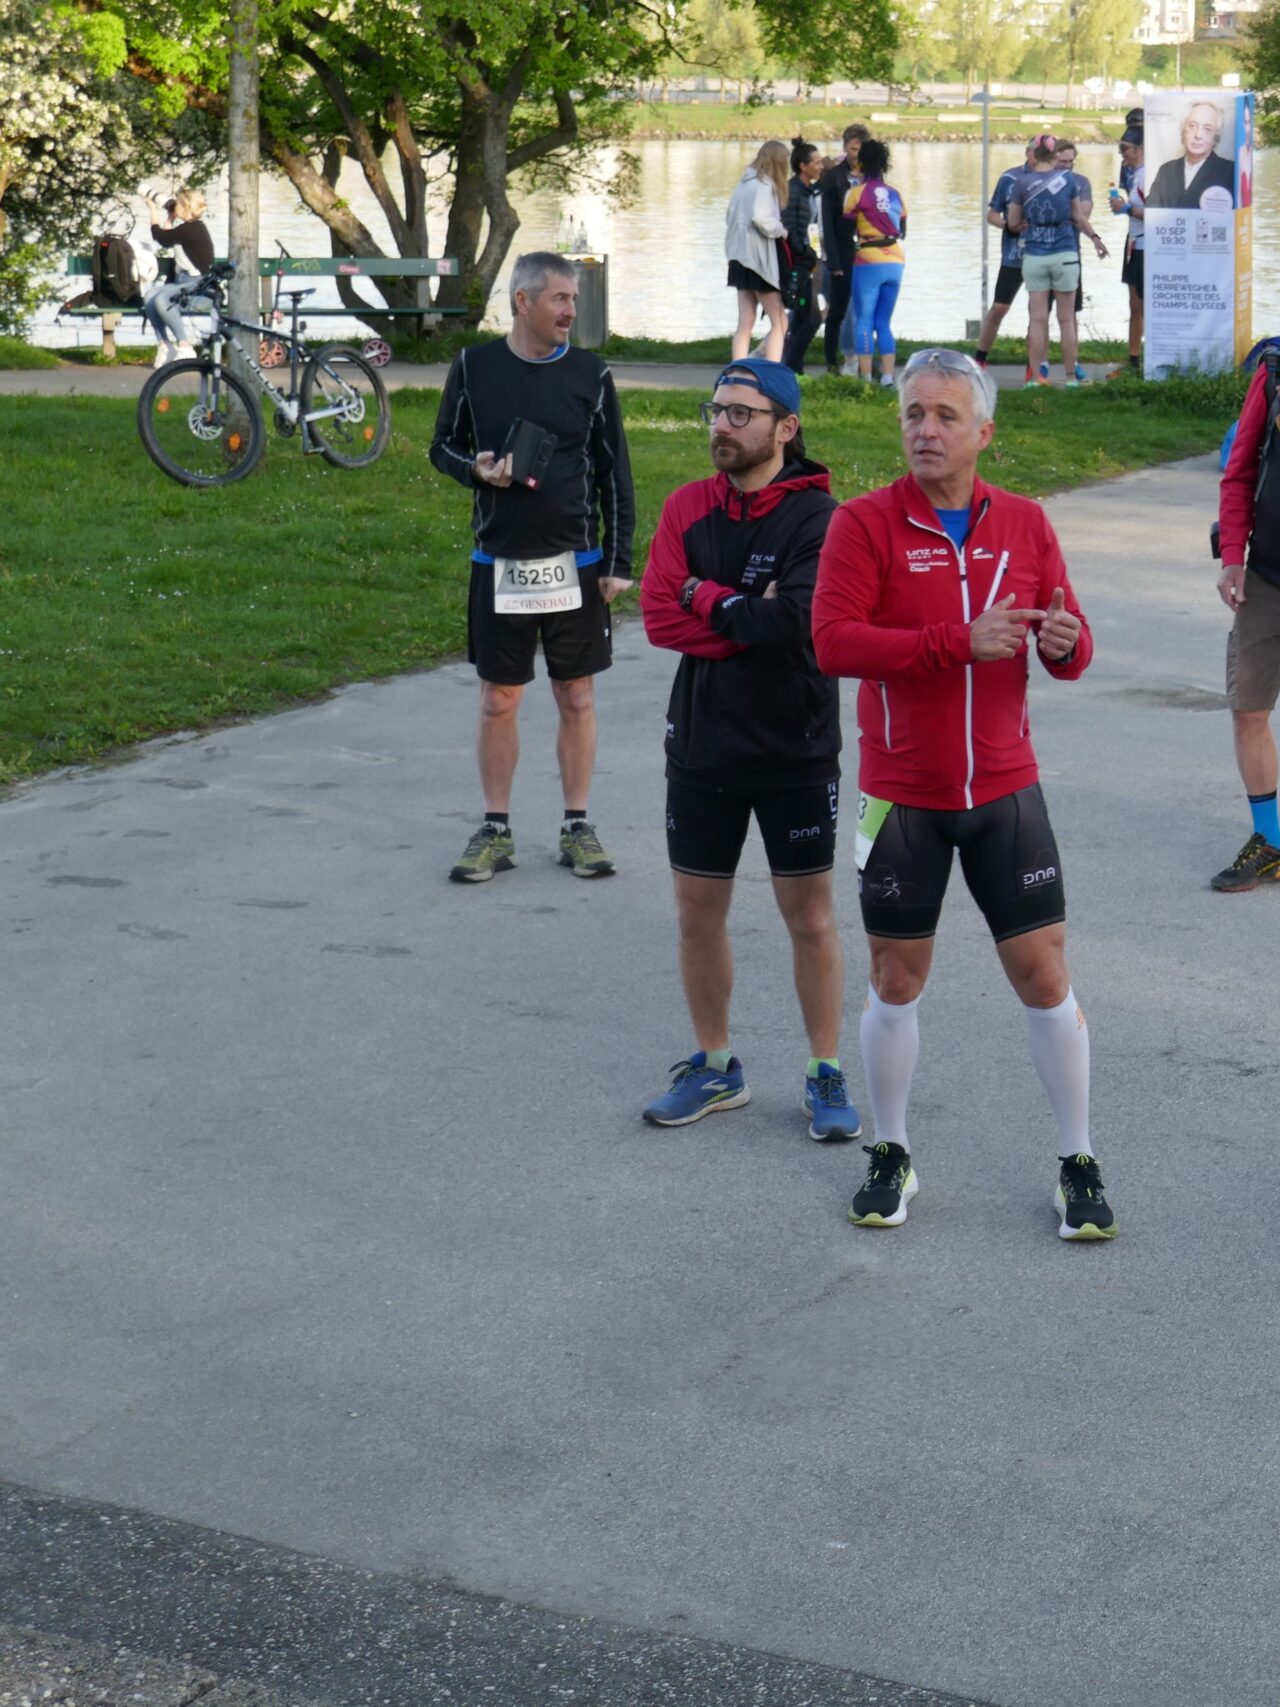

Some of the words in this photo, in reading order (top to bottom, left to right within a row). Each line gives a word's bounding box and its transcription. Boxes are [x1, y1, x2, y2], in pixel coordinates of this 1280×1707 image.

[1175, 217, 1186, 226] DI
[1155, 227, 1167, 235] 10
[1168, 227, 1186, 236] SEP
[1161, 236, 1186, 245] 19:30
[1152, 274, 1189, 282] PHILIPPE
[1152, 283, 1210, 293] HERREWEGHE
[1152, 292, 1203, 302] ORCHESTRE
[1204, 293, 1221, 302] DES
[508, 565, 565, 585] 15250
[520, 596, 574, 610] GENERALI
[789, 826, 820, 839] DNA
[1023, 866, 1056, 884] DNA
